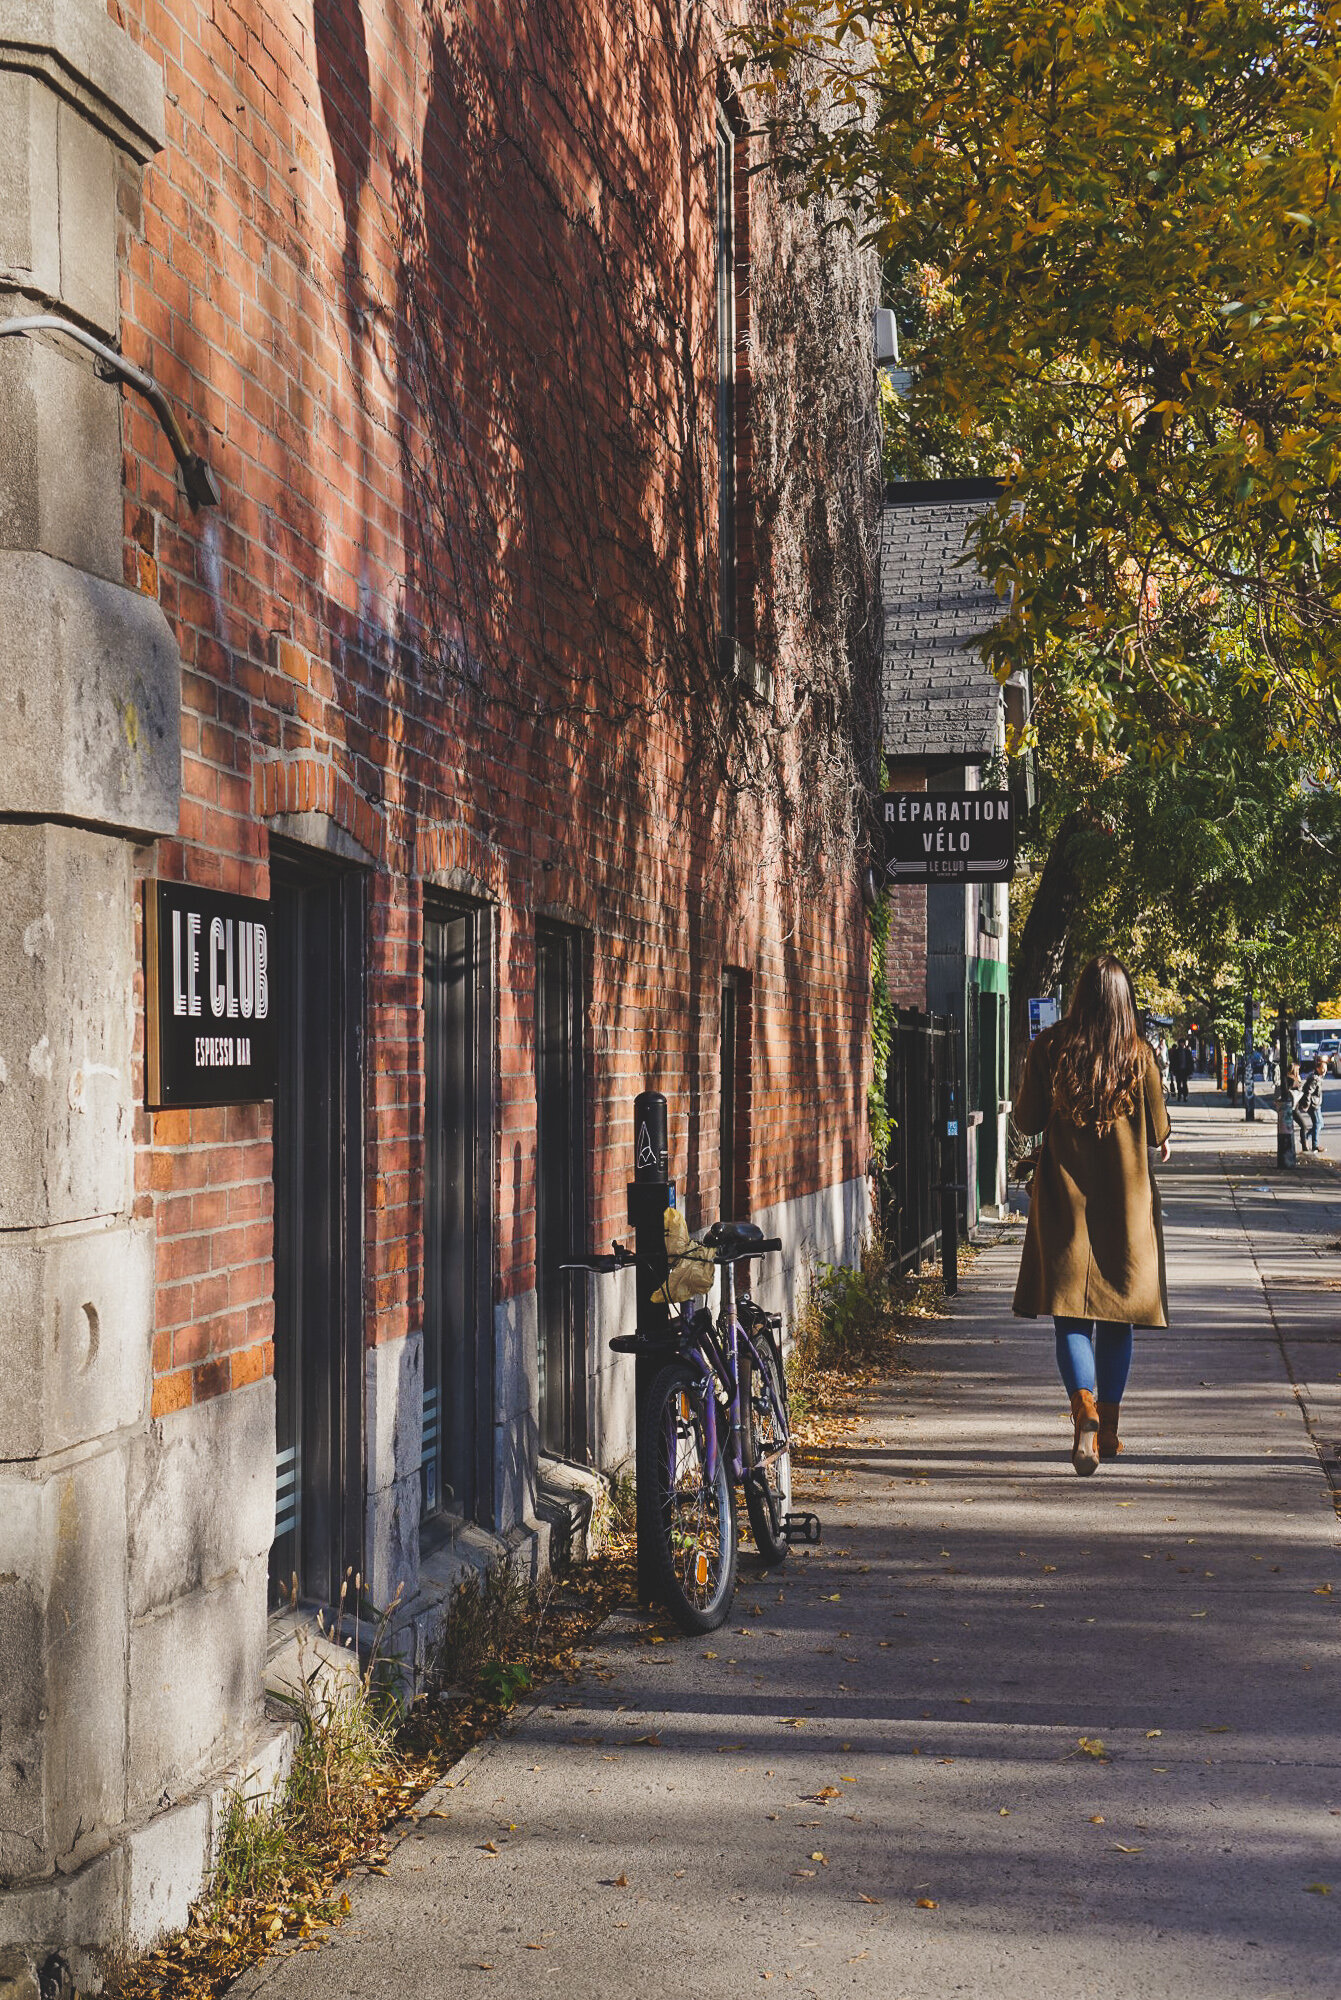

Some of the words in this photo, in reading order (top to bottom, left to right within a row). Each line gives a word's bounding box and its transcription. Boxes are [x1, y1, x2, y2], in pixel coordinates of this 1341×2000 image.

[884, 797, 1009, 822] RÉPARATION
[922, 826, 970, 852] VÉLO
[929, 860, 939, 872] LE
[942, 860, 965, 872] CLUB
[172, 910, 202, 1017] LE
[209, 916, 269, 1019] CLUB
[195, 1037, 234, 1067] ESPRESSO
[236, 1037, 251, 1066] BAR
